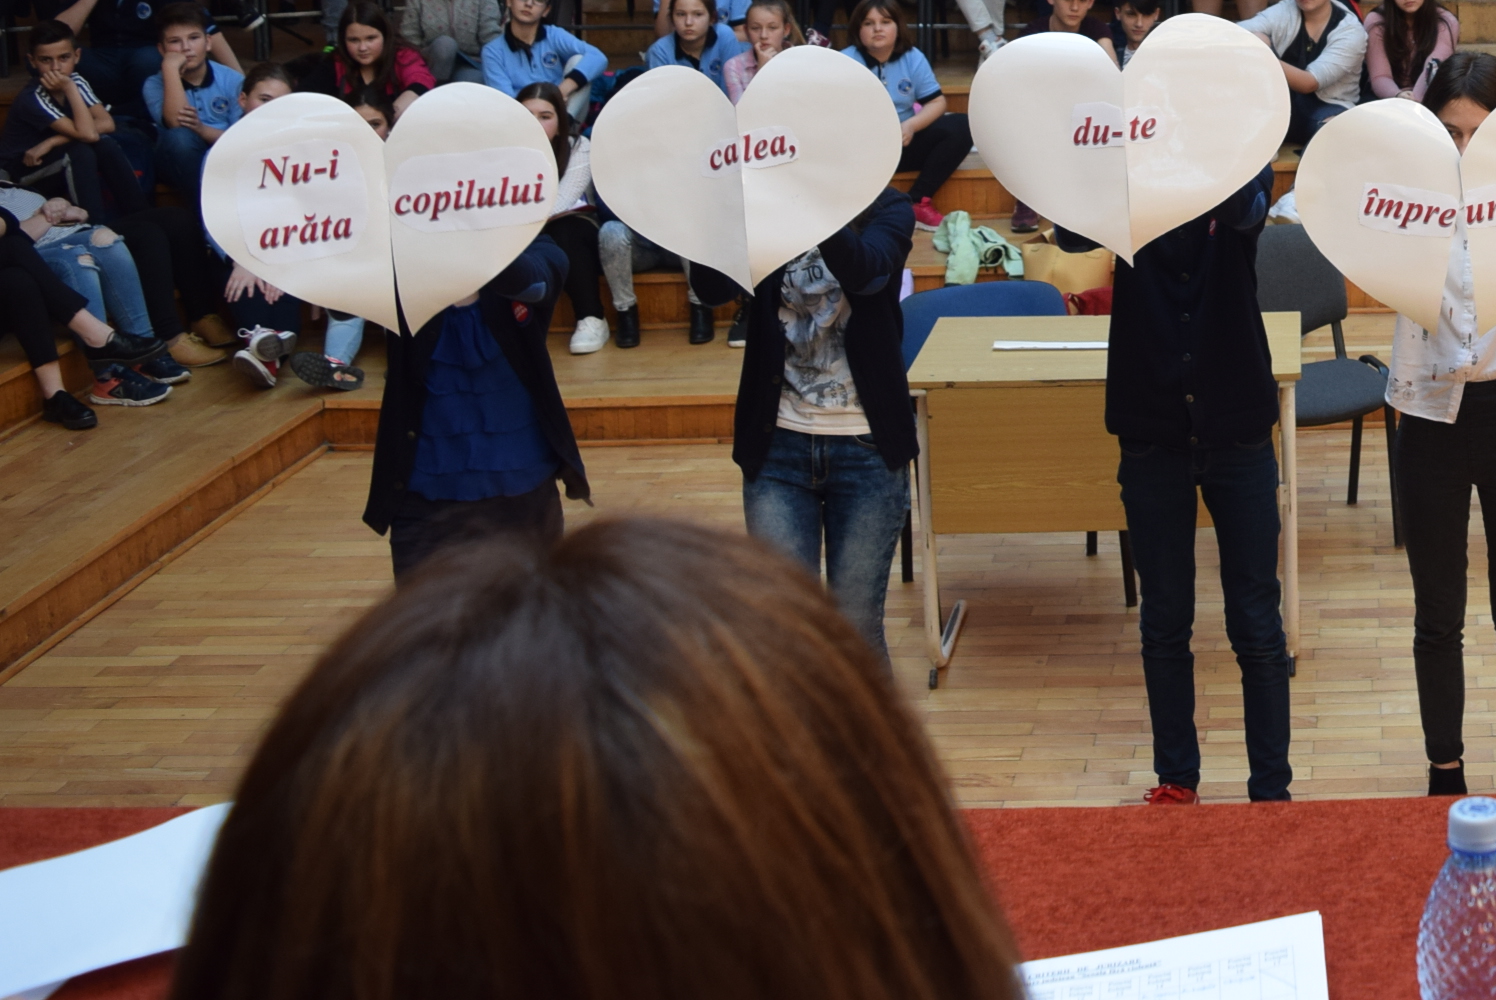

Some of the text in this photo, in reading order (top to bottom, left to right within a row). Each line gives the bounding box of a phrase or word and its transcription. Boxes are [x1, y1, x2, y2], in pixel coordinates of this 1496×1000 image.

[1073, 115, 1157, 146] du-te
[258, 149, 340, 189] Nu-i
[709, 134, 797, 171] calea,
[394, 173, 545, 222] copilului
[259, 213, 353, 250] arăta
[801, 264, 824, 283] TO
